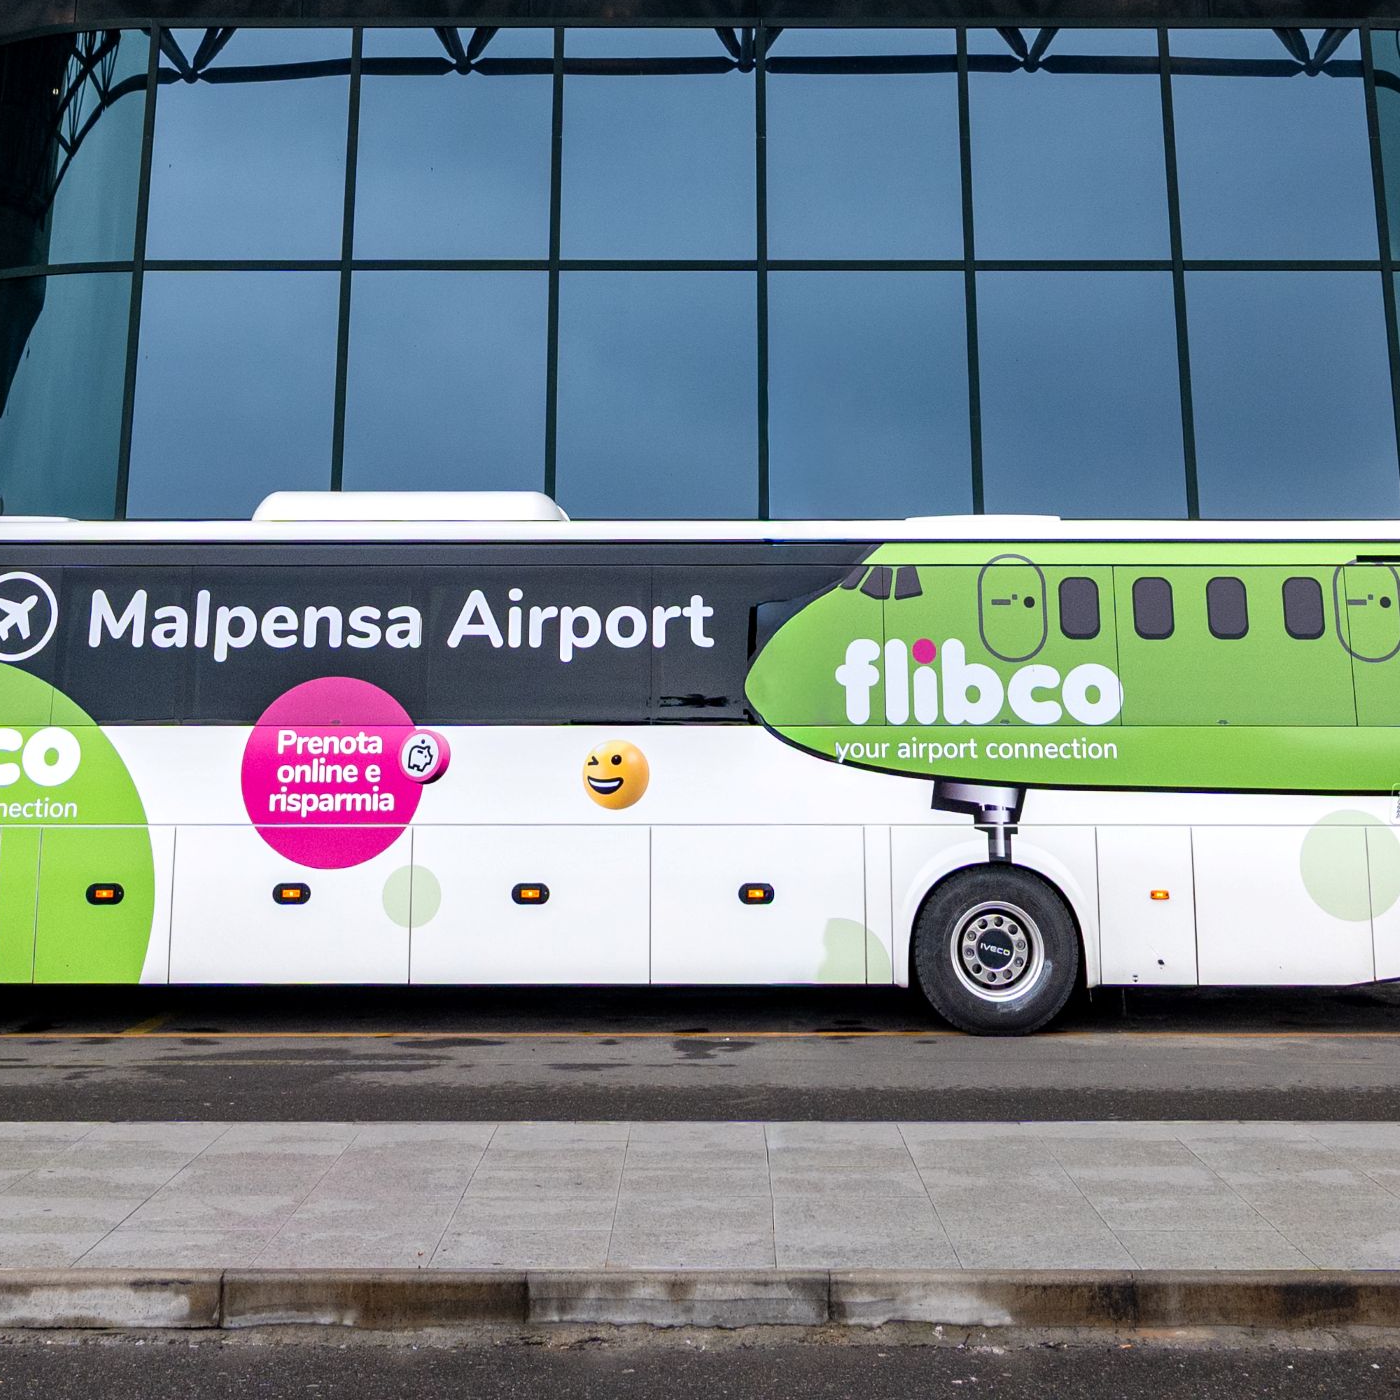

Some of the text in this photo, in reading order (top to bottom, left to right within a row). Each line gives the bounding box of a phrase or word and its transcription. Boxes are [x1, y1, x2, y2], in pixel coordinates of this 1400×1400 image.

[88, 587, 715, 663] Malpensa Airport
[835, 638, 1124, 725] flibco
[277, 729, 383, 755] Prenota
[835, 737, 1118, 763] your airport connection
[276, 757, 382, 783] online e
[268, 785, 395, 818] risparmia
[980, 942, 1011, 956] IVECO
